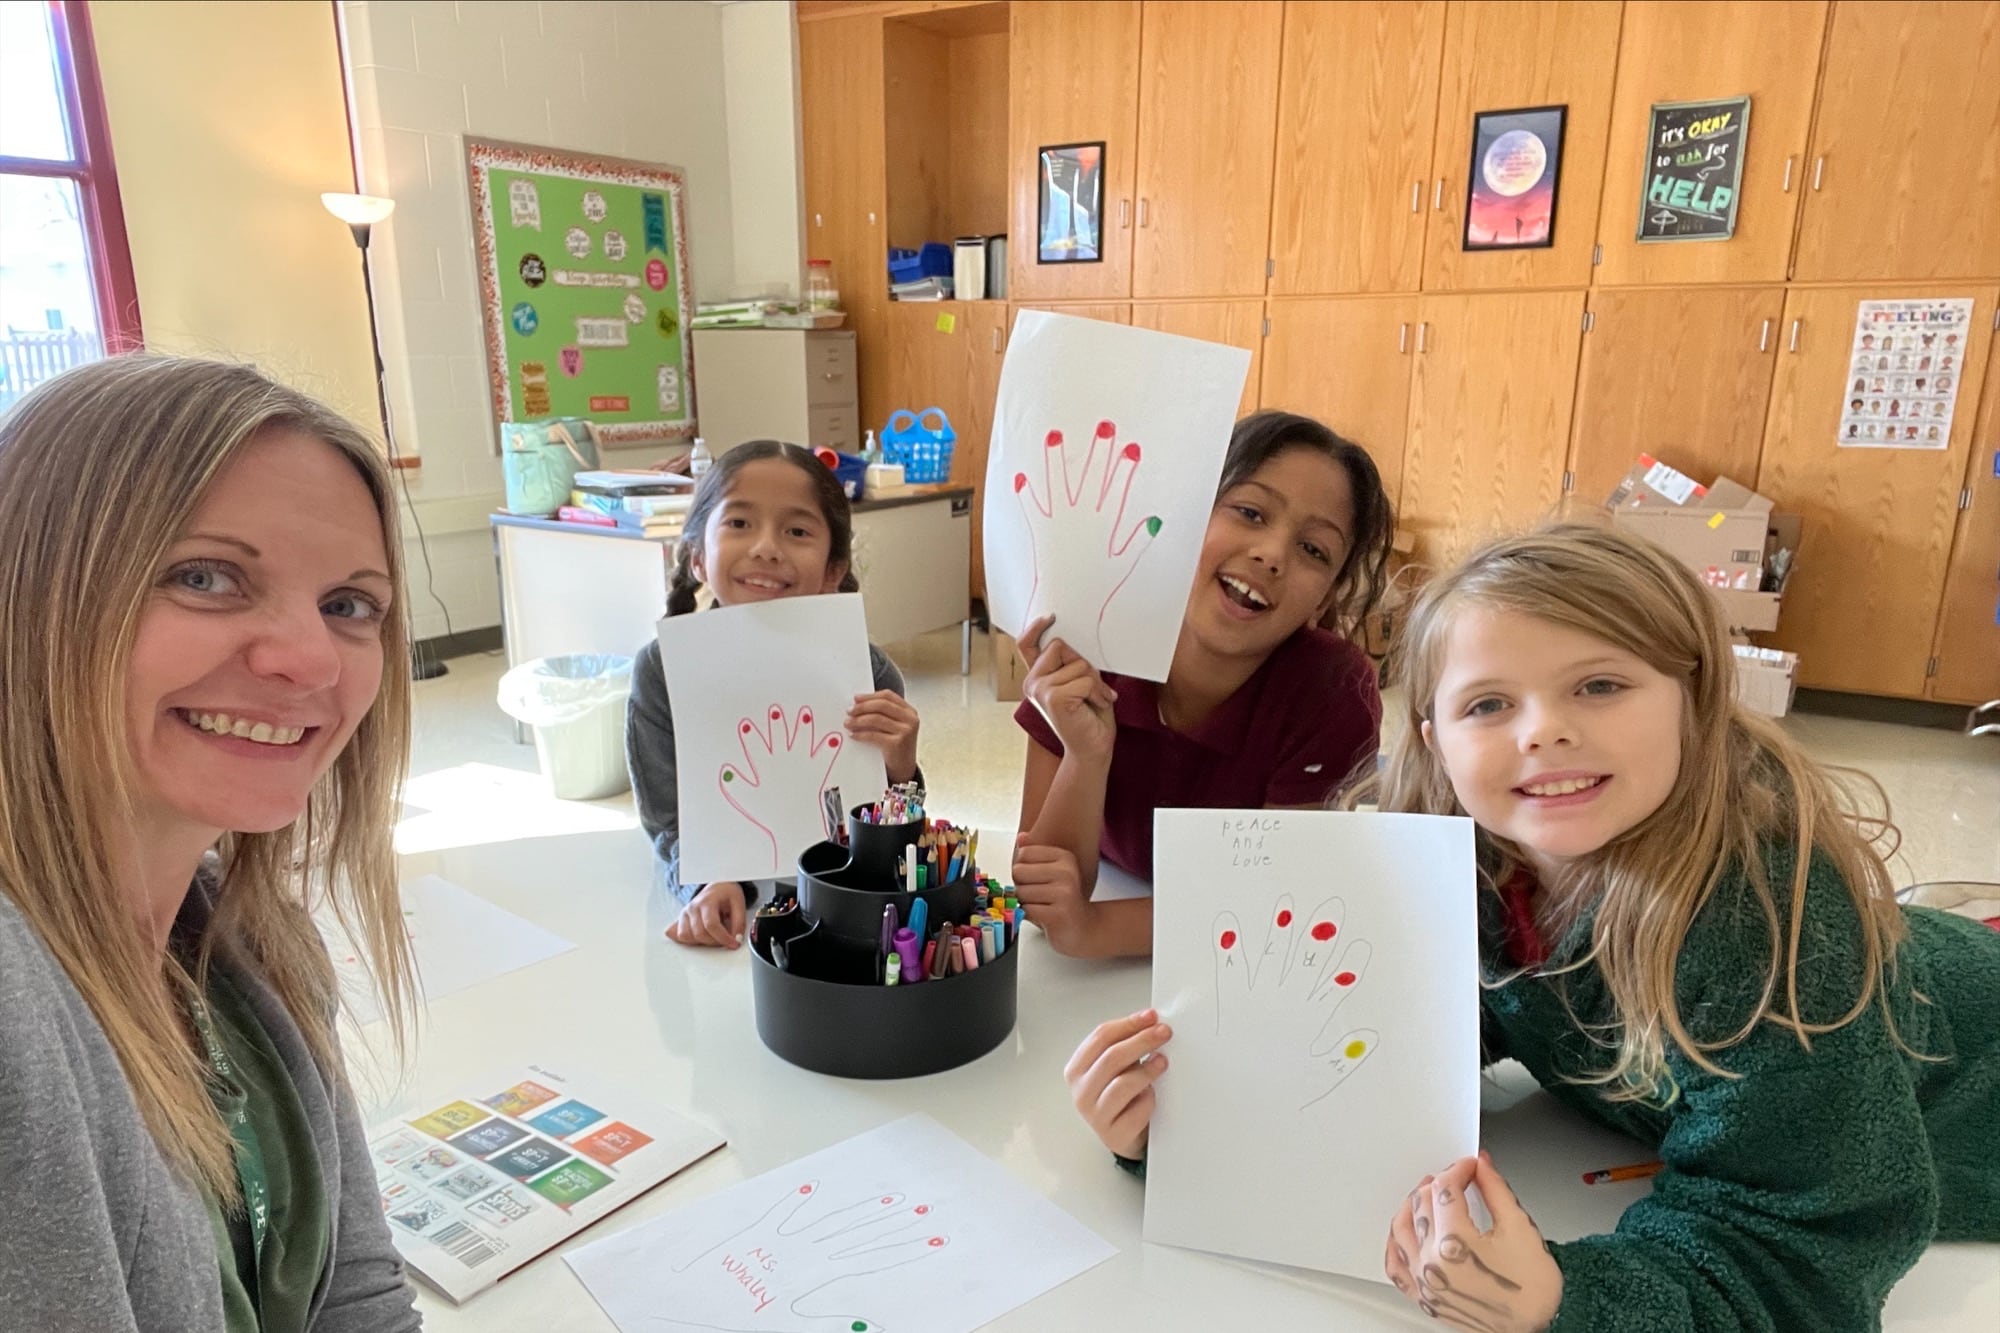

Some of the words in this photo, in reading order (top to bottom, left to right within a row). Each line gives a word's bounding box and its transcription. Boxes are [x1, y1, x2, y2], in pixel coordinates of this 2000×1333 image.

[1688, 111, 1732, 138] OKAY
[1656, 155, 1671, 167] to
[1705, 143, 1730, 161] for
[1649, 173, 1732, 213] HELP
[486, 1192, 528, 1217] SPOTS
[721, 1254, 776, 1313] Whaley
